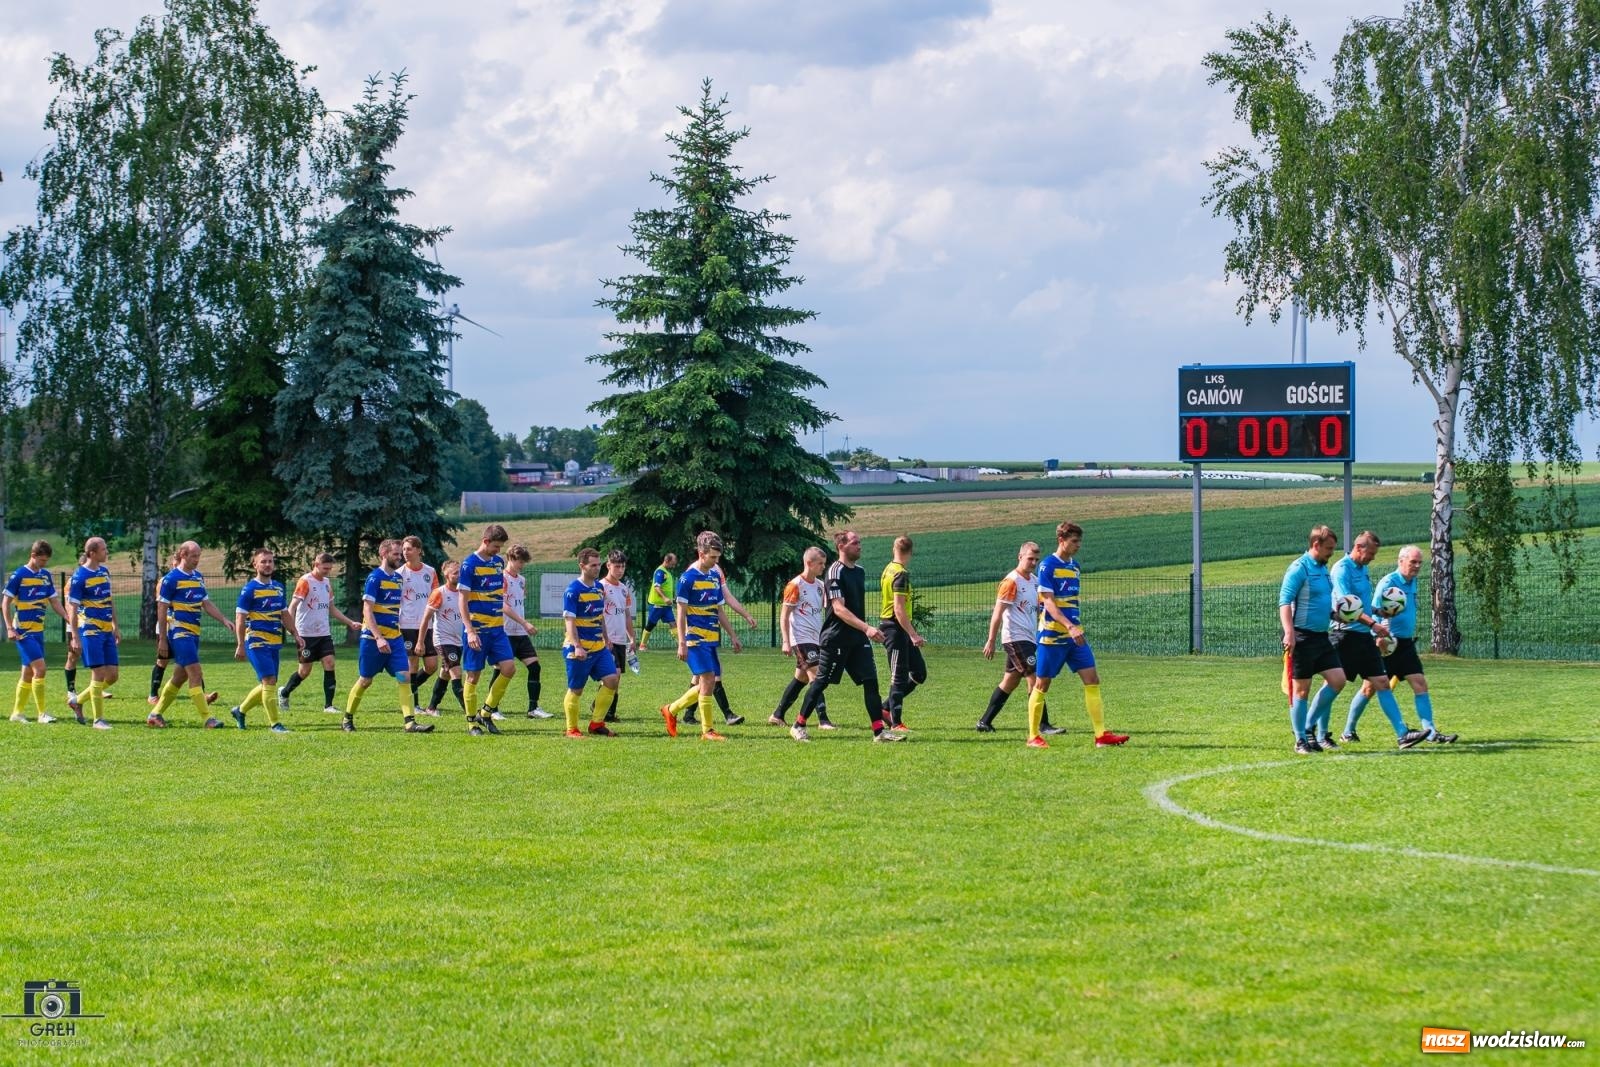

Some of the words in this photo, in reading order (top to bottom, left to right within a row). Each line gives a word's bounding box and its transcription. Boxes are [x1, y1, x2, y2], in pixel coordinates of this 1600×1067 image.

[1205, 375, 1225, 384] LKS
[1187, 385, 1243, 405] GAMÓW
[1286, 382, 1344, 404] GOŚCIE
[1186, 417, 1208, 457] 0
[1320, 416, 1343, 456] 0
